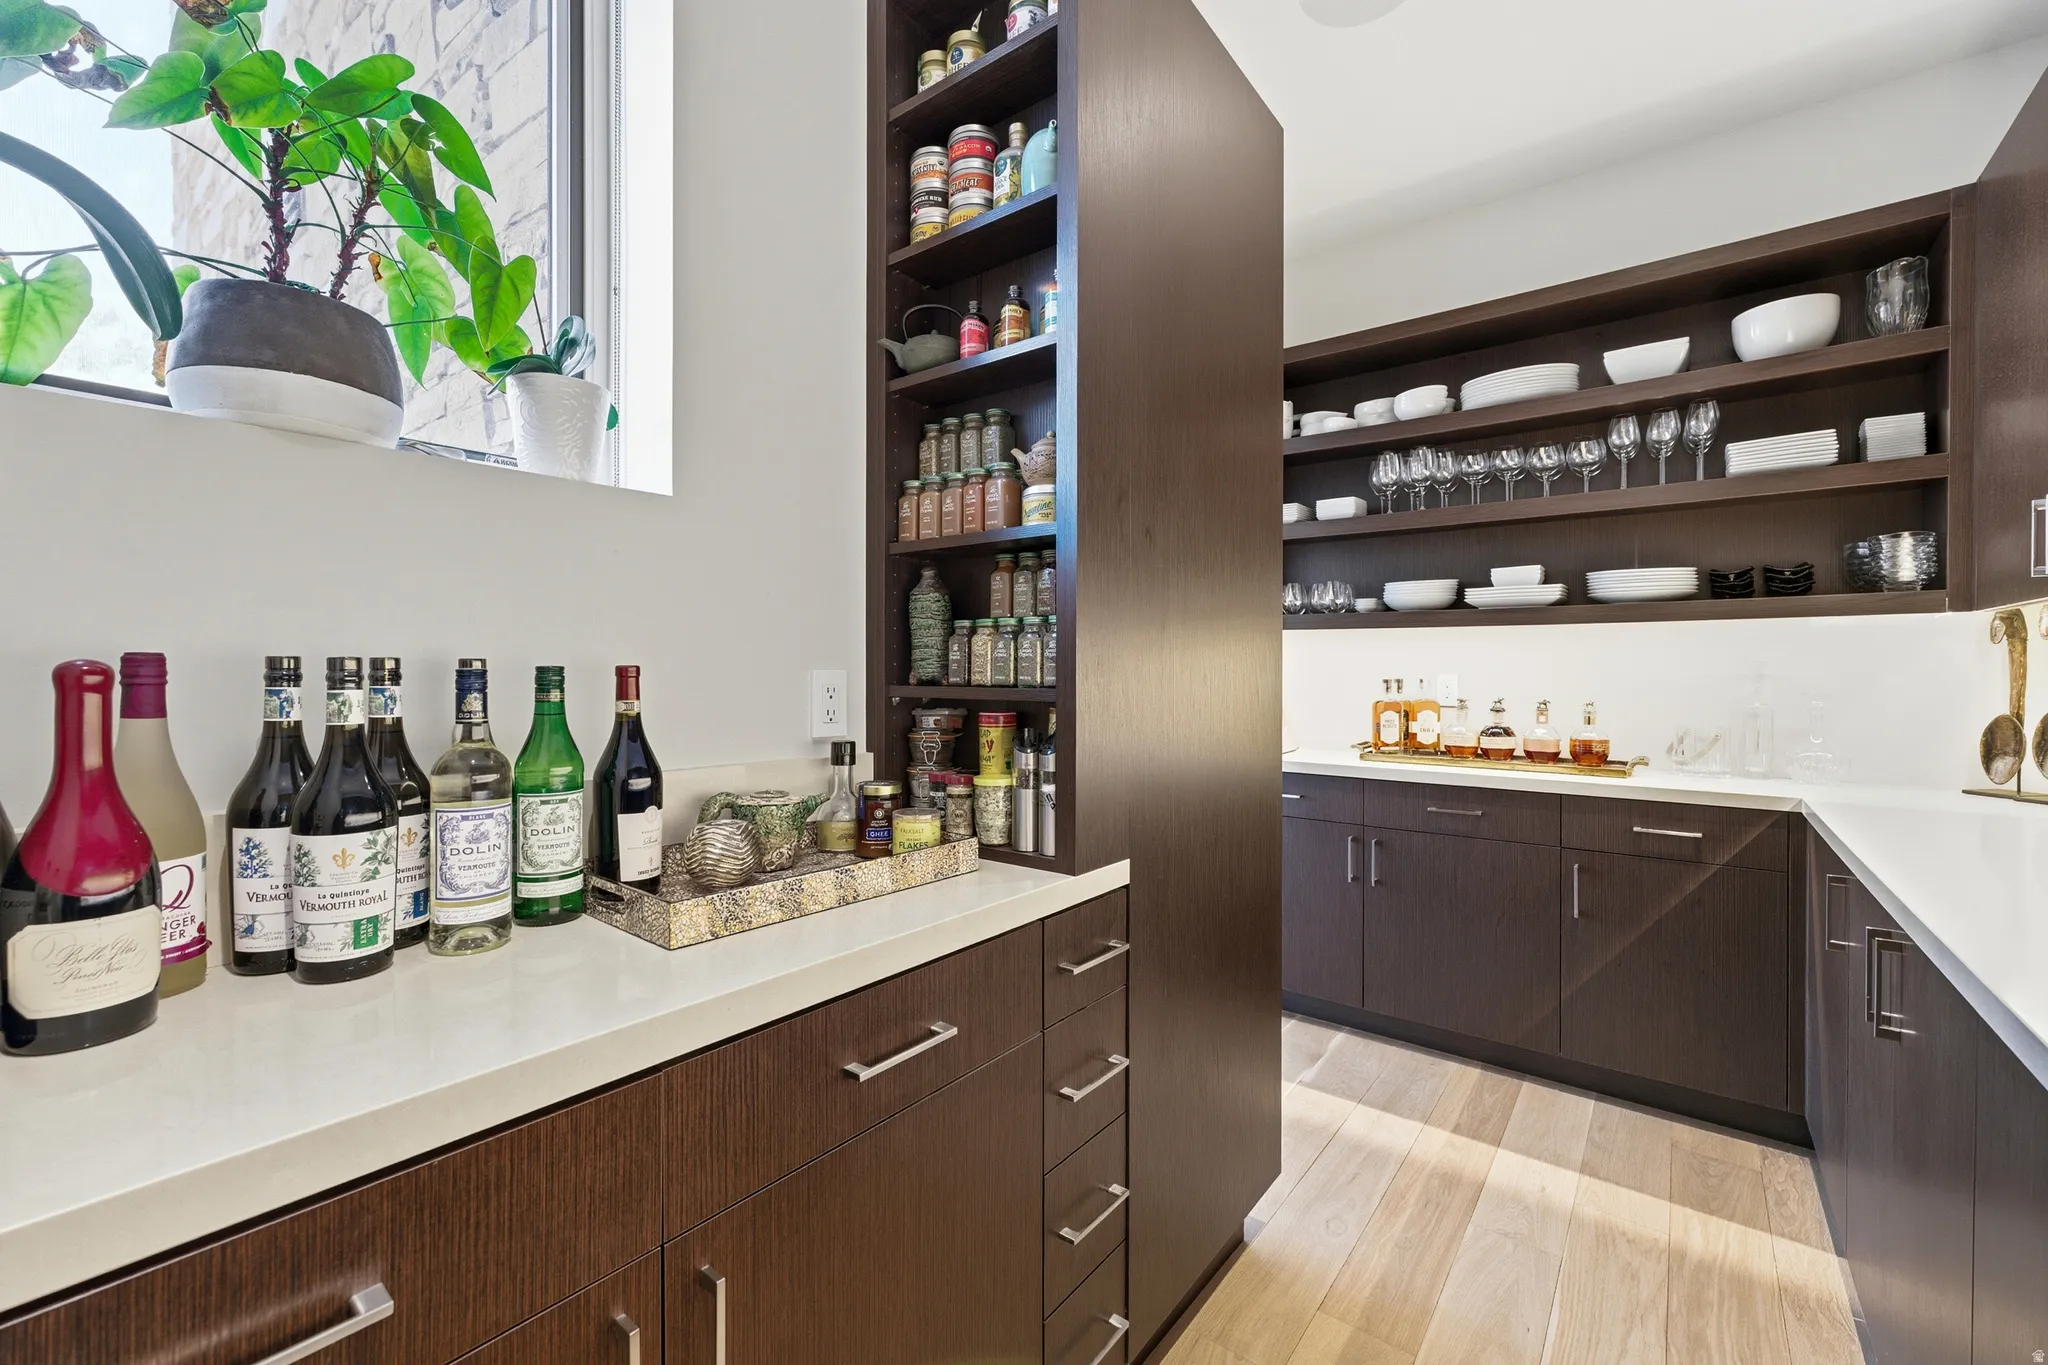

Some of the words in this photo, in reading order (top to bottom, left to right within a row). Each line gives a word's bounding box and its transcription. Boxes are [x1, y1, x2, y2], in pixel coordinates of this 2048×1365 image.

[530, 825, 575, 837] DOLIN
[449, 843, 502, 857] DOLIN
[246, 891, 293, 903] VERMOU
[299, 900, 356, 912] VERMOUTH
[359, 890, 388, 907] ROYAL
[161, 915, 197, 931] NGER
[160, 929, 187, 944] EER
